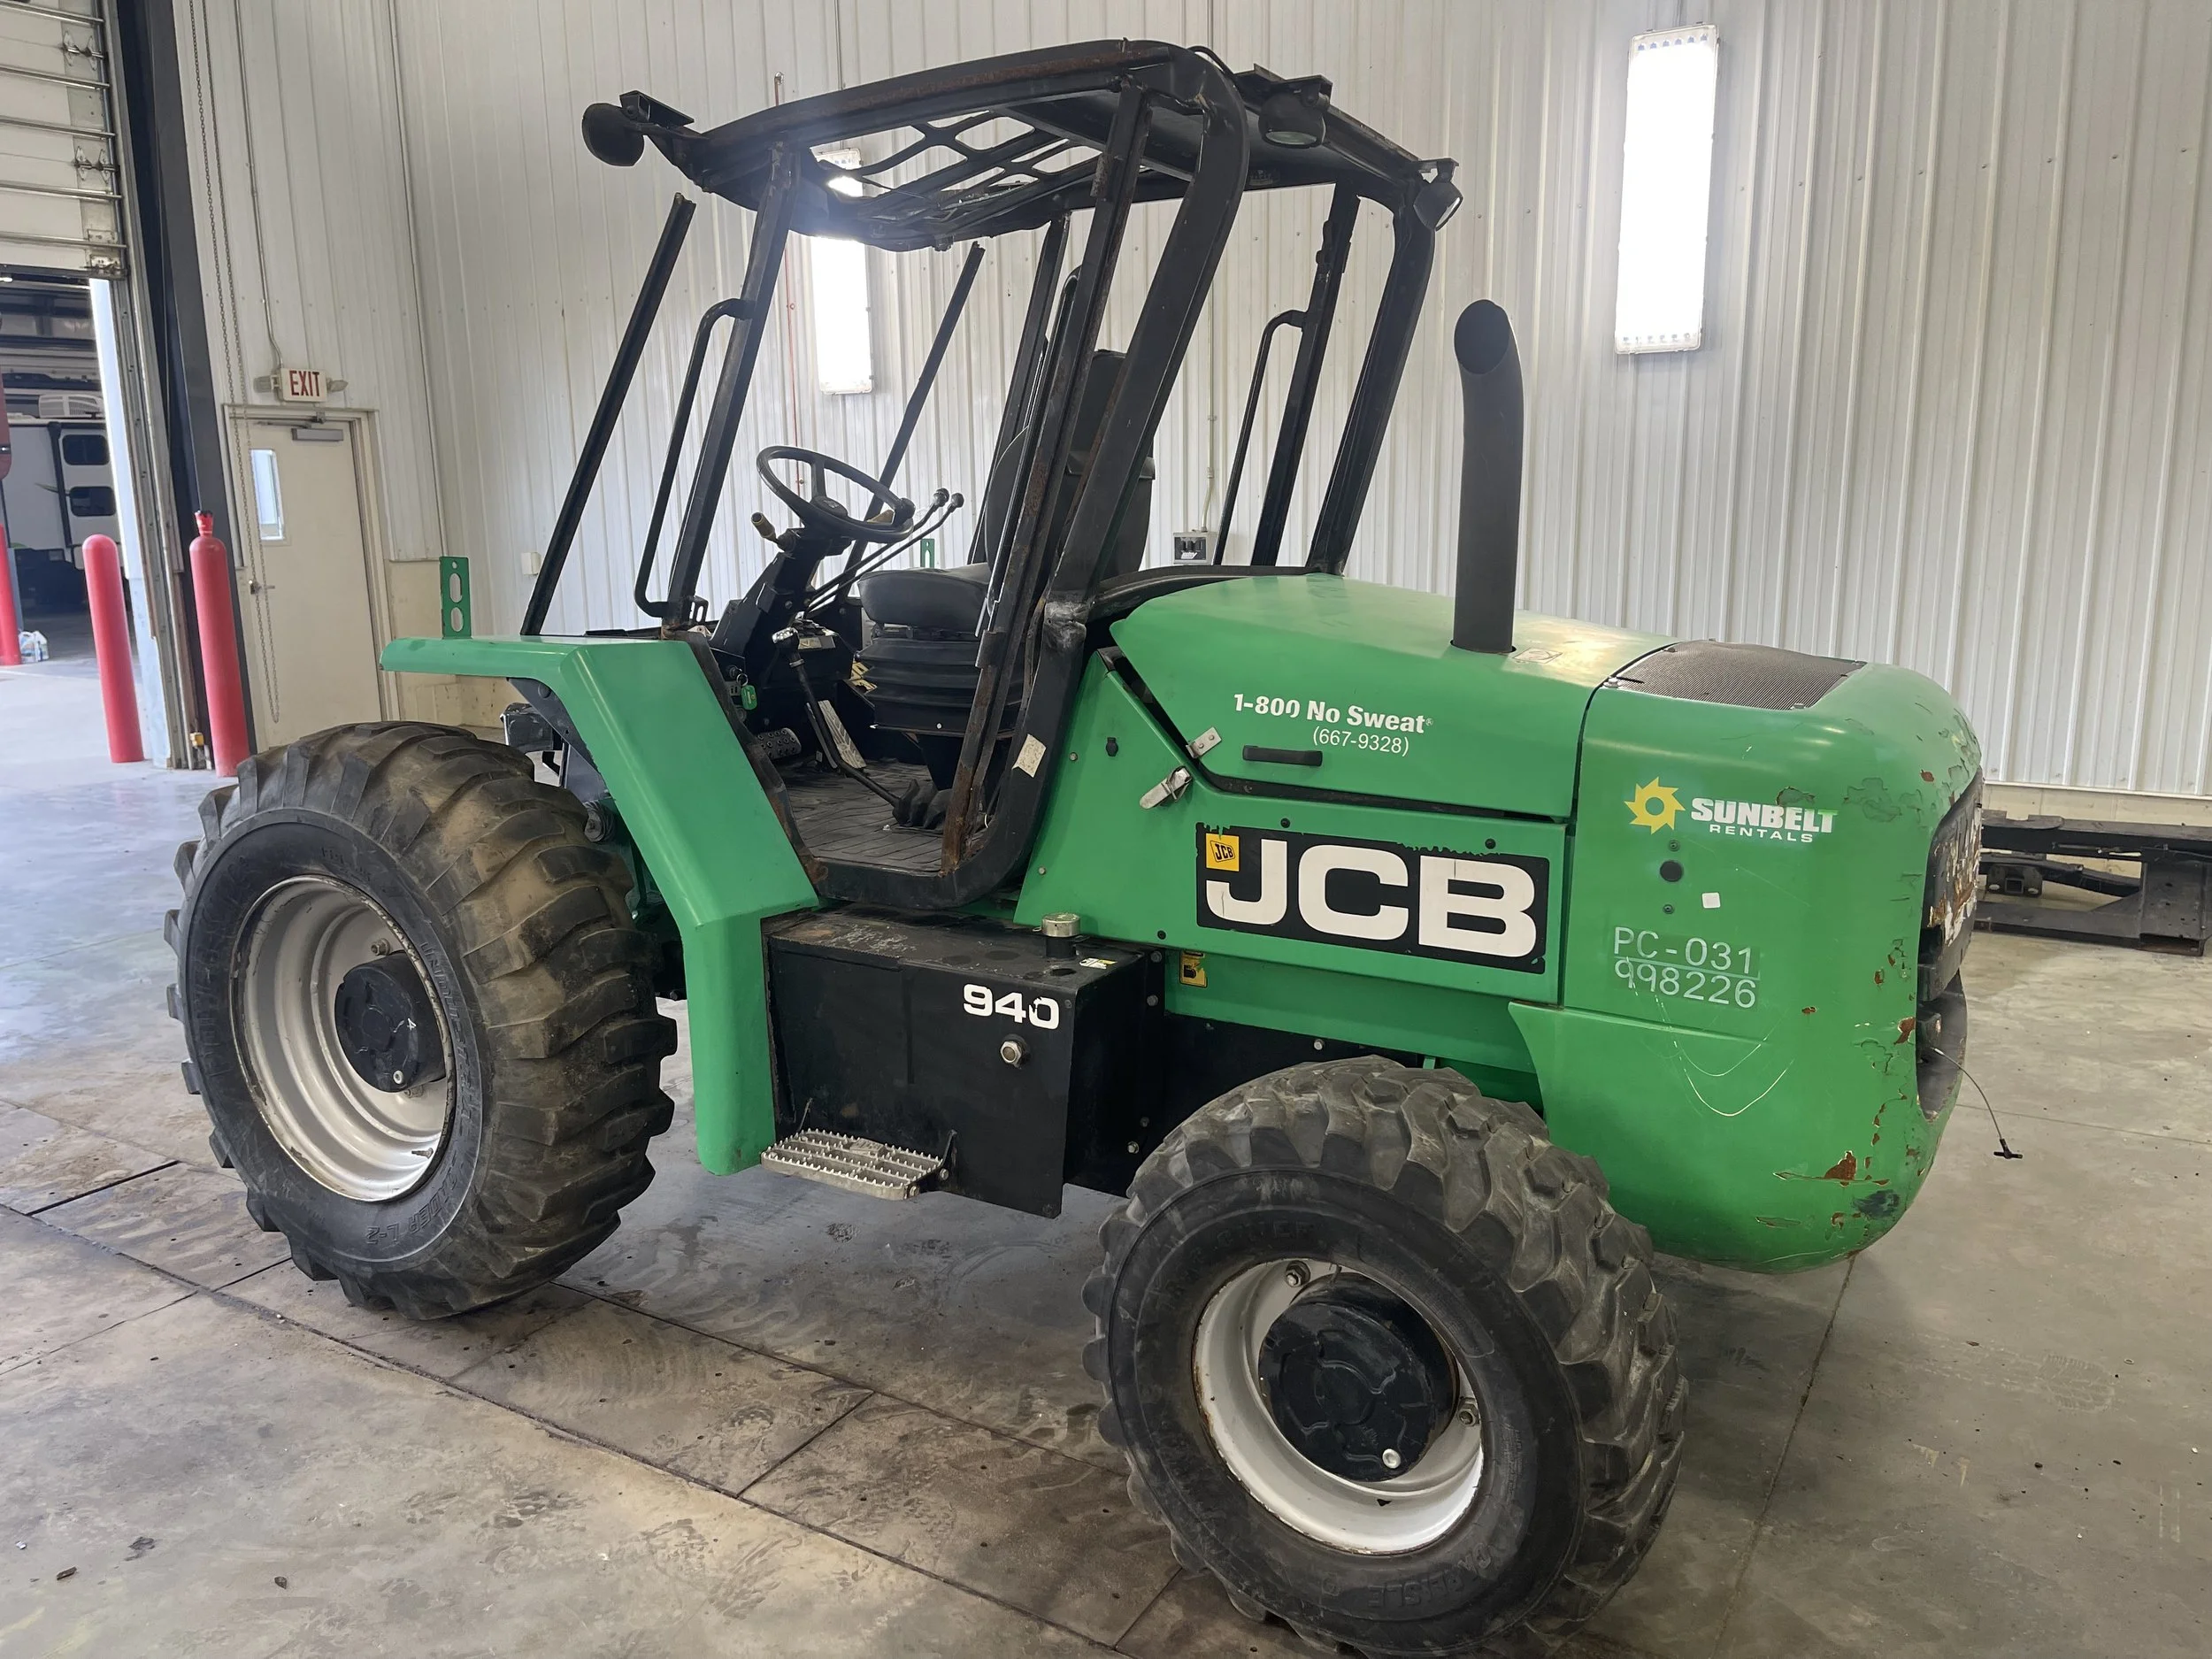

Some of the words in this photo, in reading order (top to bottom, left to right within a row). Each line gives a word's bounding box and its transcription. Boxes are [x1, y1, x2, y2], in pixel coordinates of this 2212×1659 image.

[288, 370, 320, 397] EXIT
[1233, 693, 1301, 718] 1-800
[1306, 700, 1341, 723] No
[1312, 726, 1409, 757] (667-9328)
[1690, 796, 1840, 833] SUNBELT
[1709, 824, 1814, 843] RENTALS
[1214, 842, 1234, 861] JCB
[1205, 838, 1538, 958] JCB
[1613, 926, 1753, 974] PC-031
[1614, 958, 1757, 1009] 998226
[963, 983, 1060, 1030] 940
